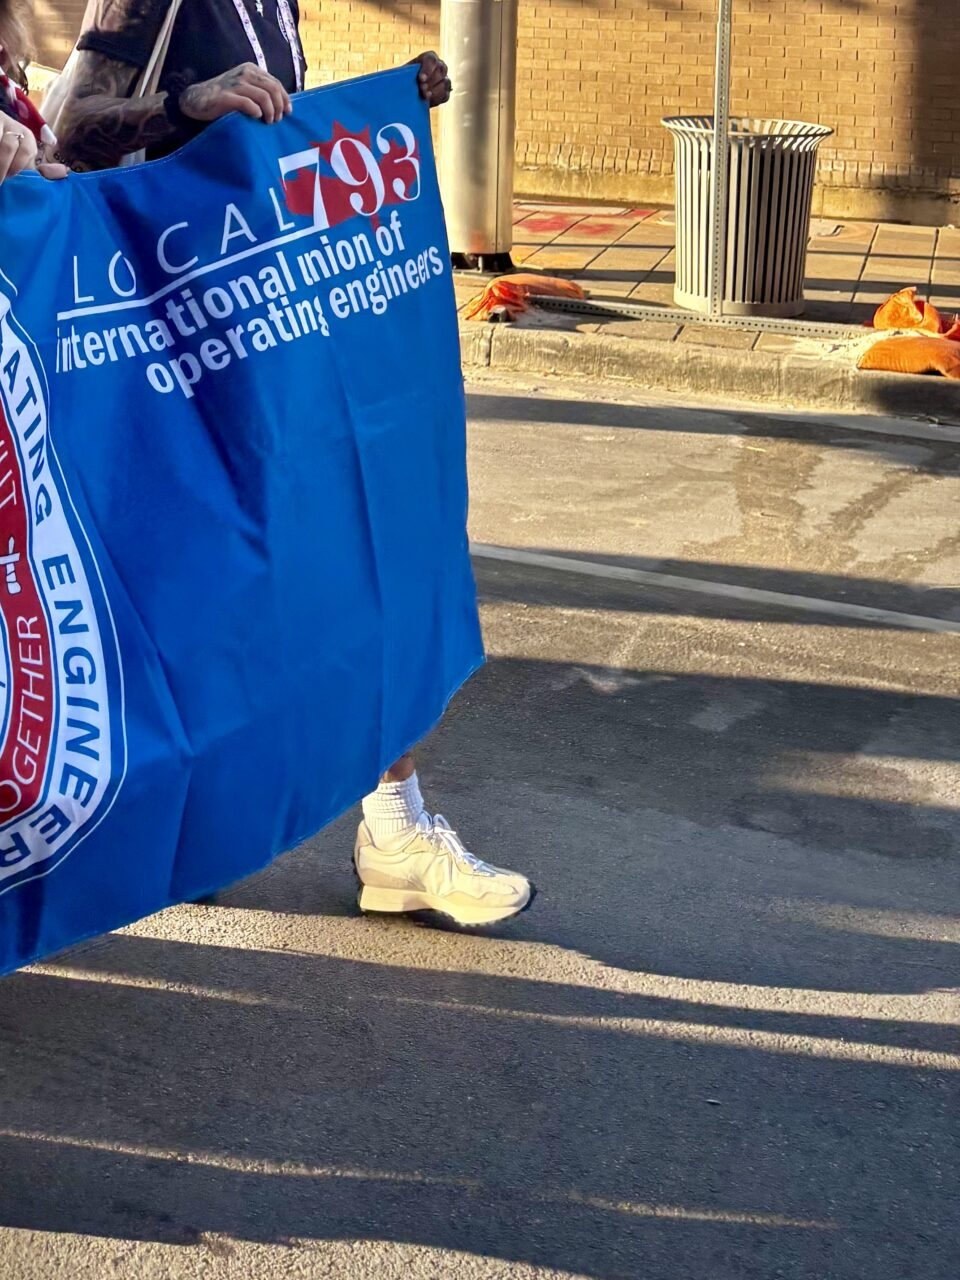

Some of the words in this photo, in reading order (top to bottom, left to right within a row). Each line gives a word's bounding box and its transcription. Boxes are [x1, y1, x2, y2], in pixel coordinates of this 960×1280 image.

[55, 251, 297, 375] international
[375, 210, 405, 257] of
[72, 185, 295, 305] LOCAL
[277, 122, 422, 231] 793
[329, 243, 444, 319] engineers
